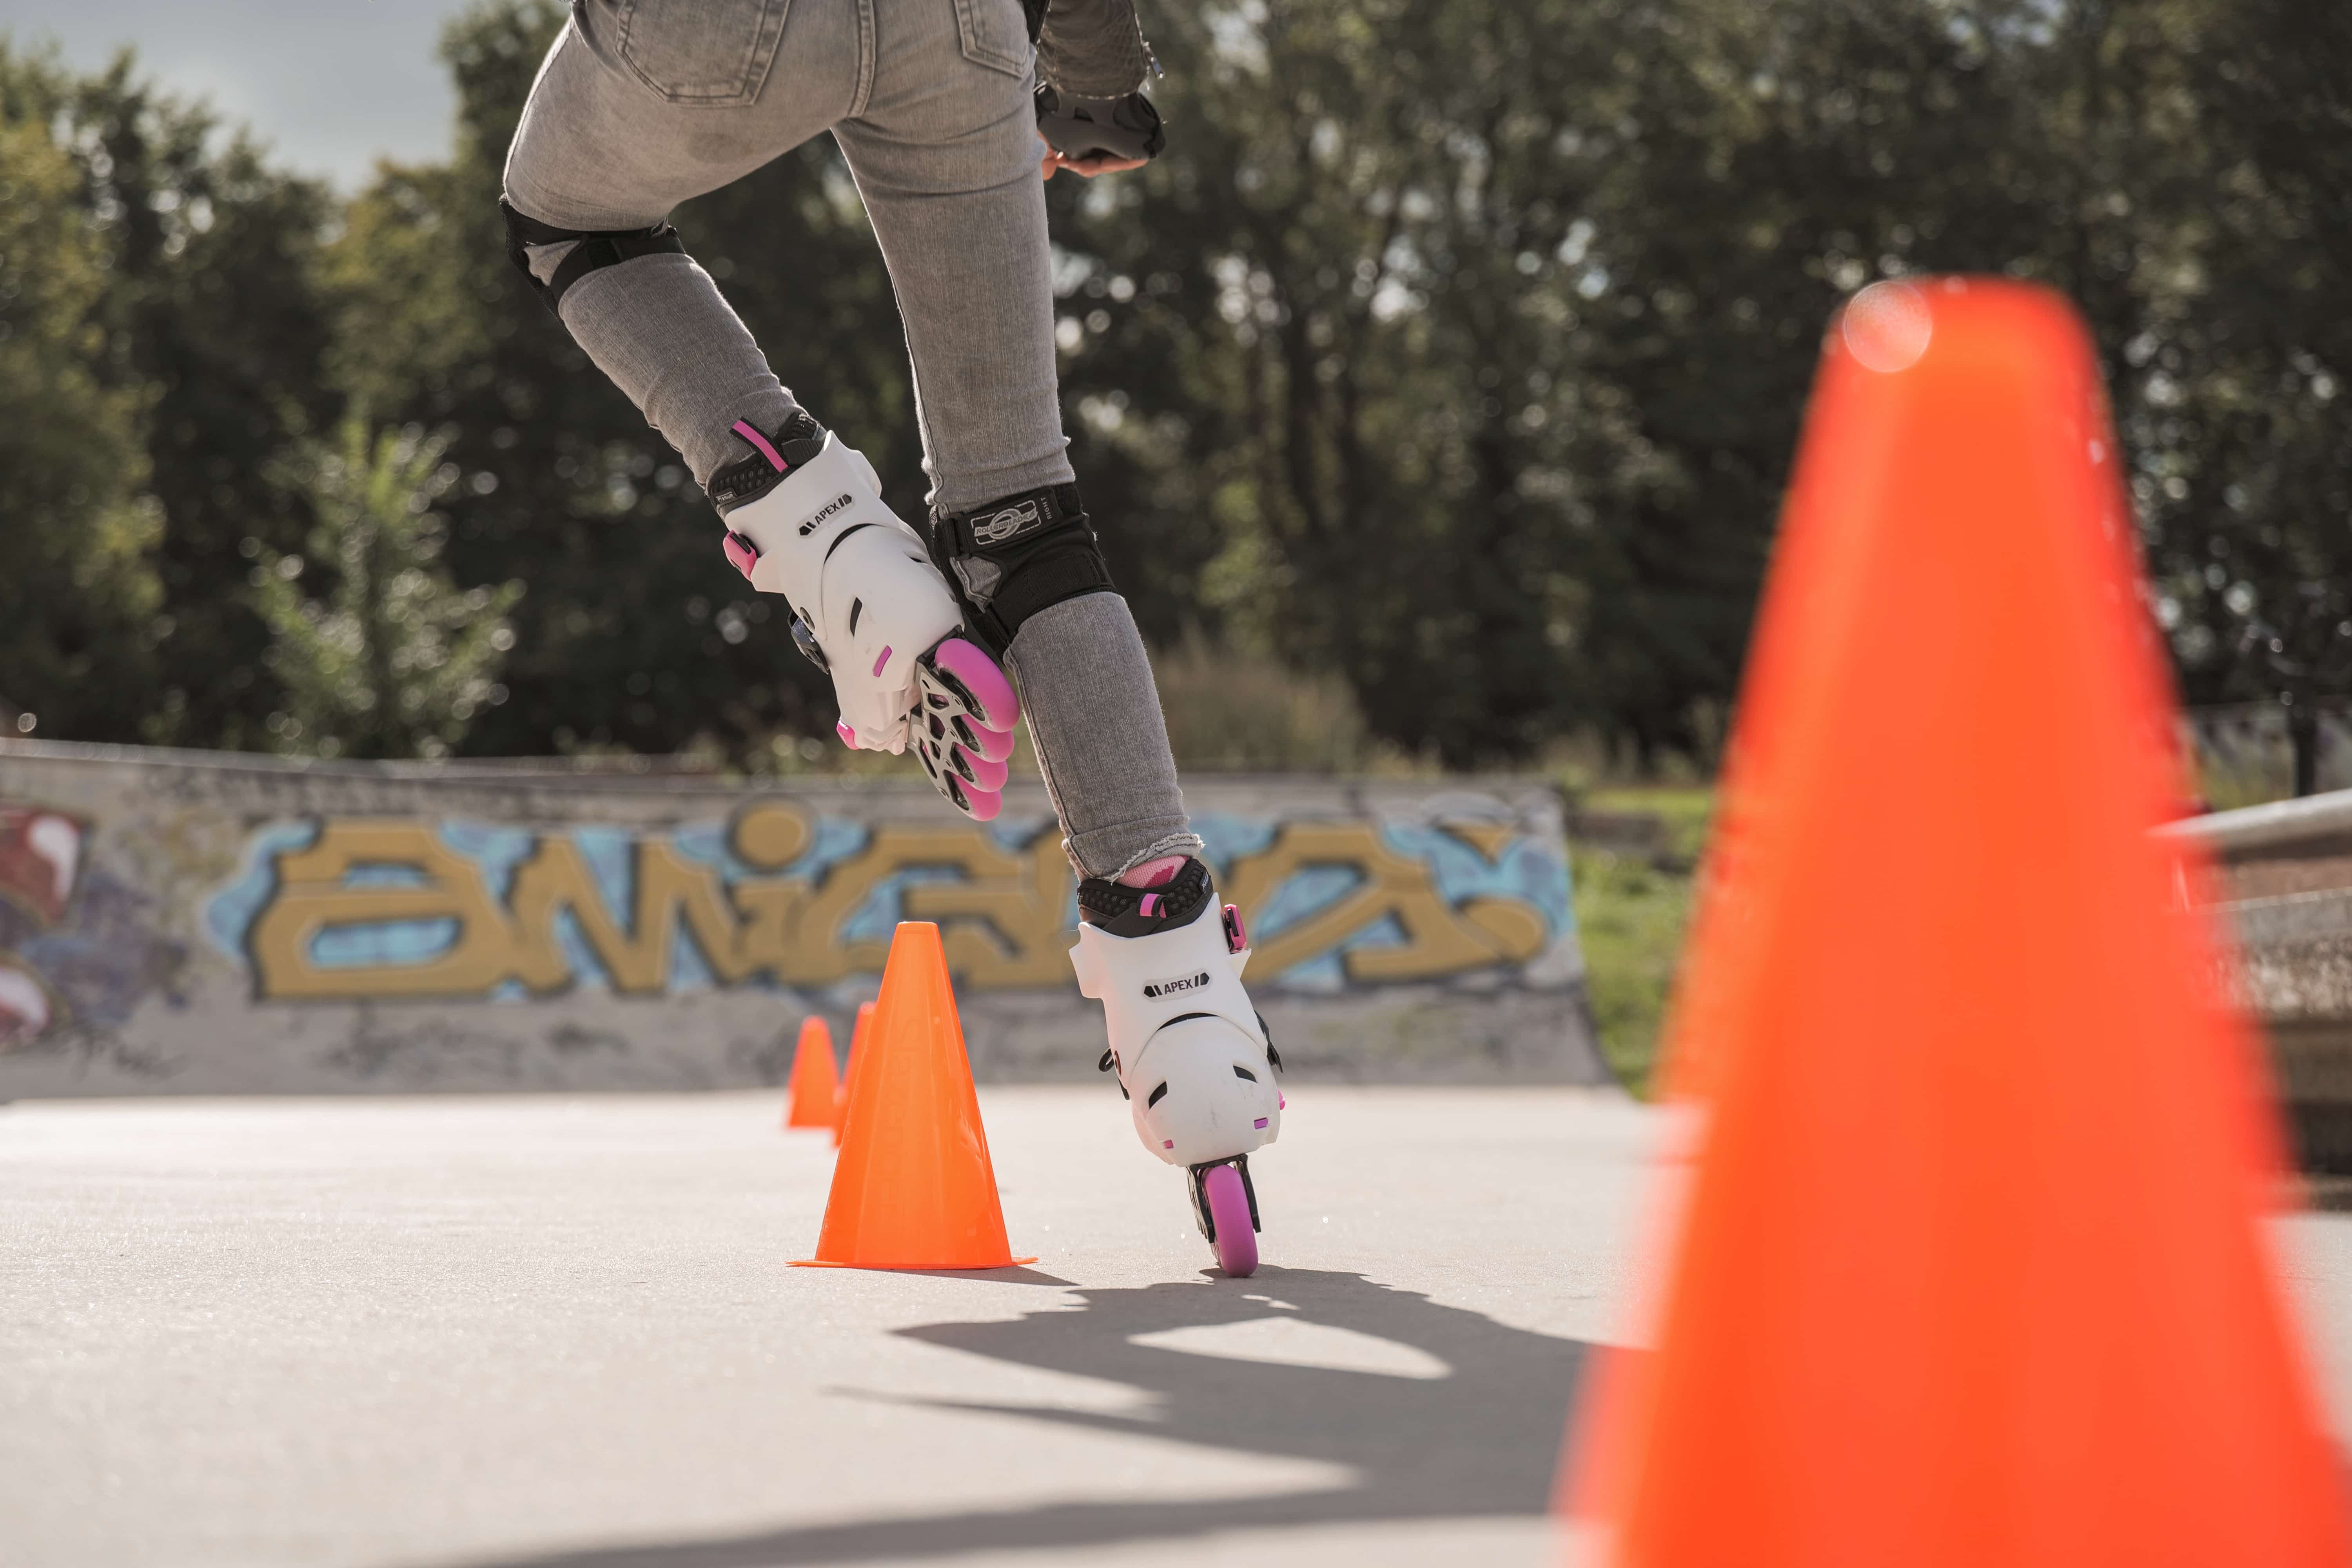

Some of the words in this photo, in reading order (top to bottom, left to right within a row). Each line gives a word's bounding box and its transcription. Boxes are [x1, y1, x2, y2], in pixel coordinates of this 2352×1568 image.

[815, 503, 840, 524] APEX
[1041, 497, 1052, 520] RIGHT
[1165, 979, 1193, 995] APEX
